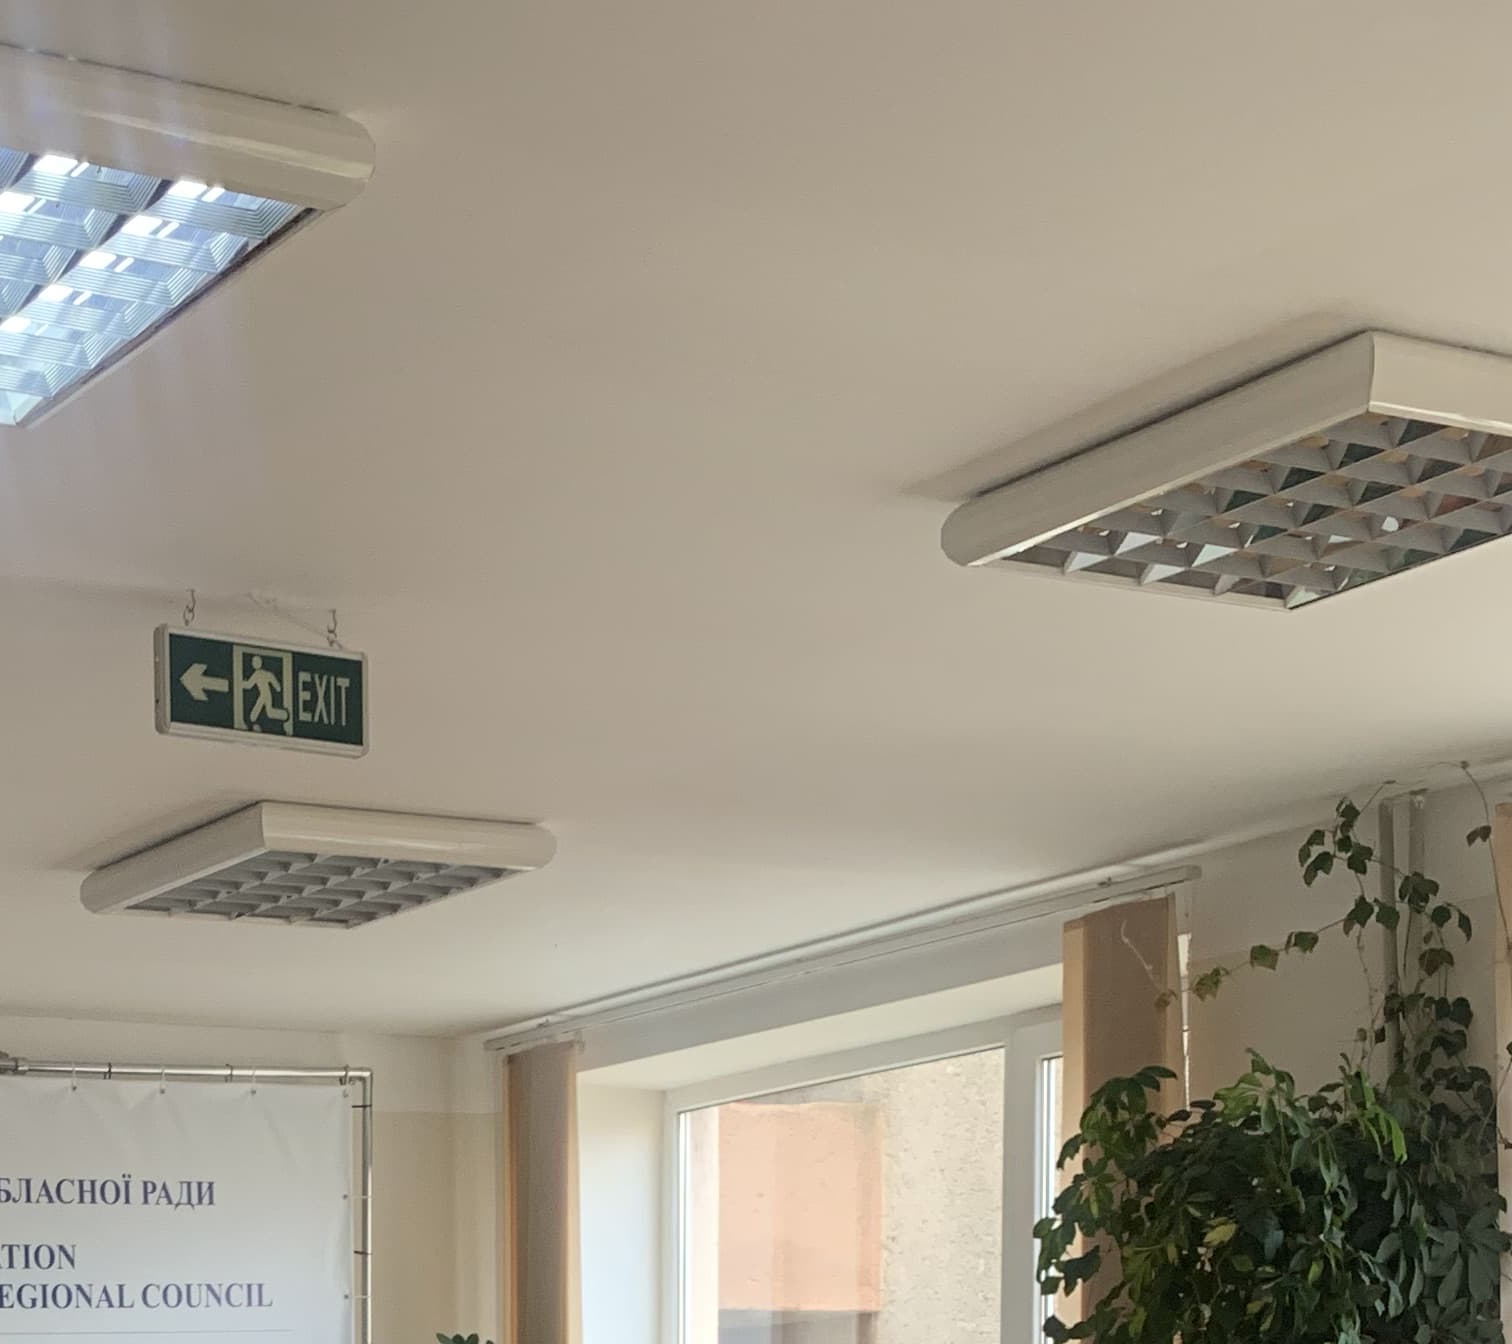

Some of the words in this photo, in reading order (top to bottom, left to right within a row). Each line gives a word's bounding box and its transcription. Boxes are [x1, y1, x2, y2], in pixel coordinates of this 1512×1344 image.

[297, 671, 351, 727] EXIT
[141, 1180, 215, 1211] РАДИ
[141, 1283, 274, 1309] COUNCIL
